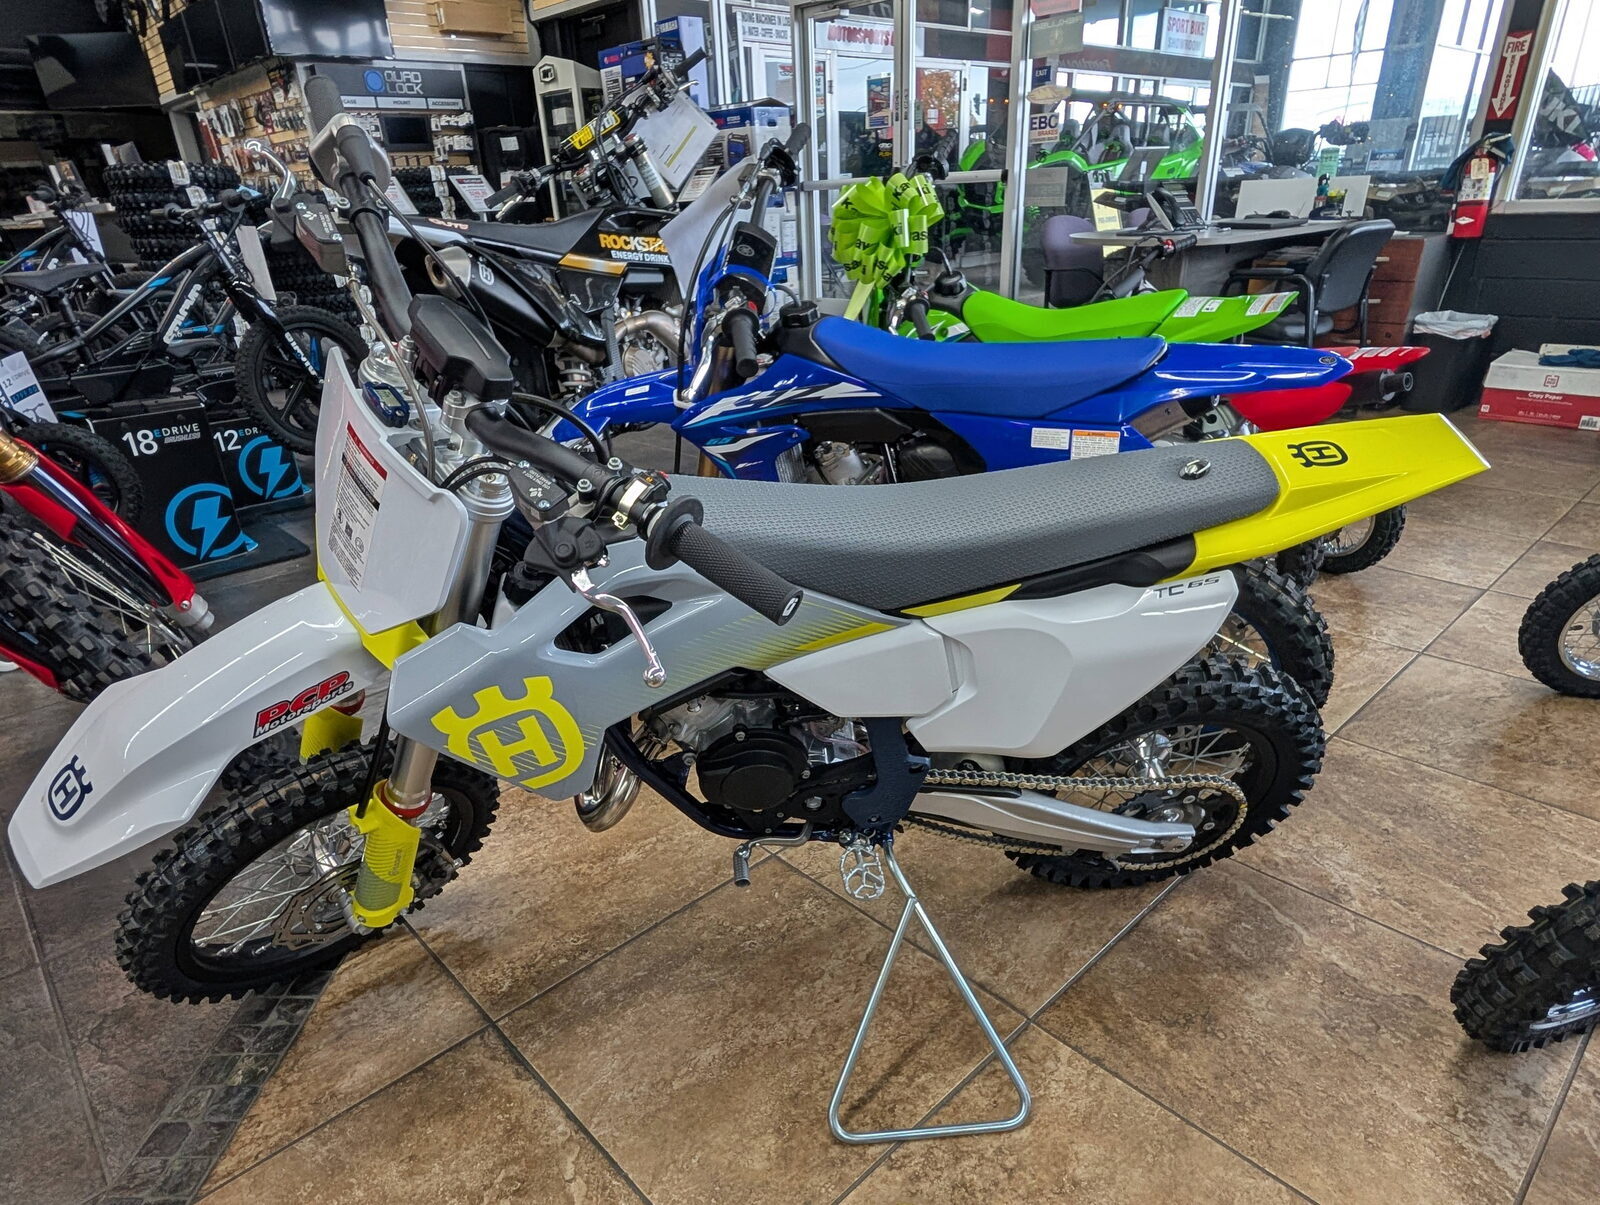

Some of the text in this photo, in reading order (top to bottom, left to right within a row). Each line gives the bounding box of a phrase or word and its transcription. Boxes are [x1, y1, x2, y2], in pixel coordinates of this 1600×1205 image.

[827, 24, 890, 46] MOTORSPORTS
[1168, 16, 1205, 36] SPORT BIKE
[1506, 40, 1527, 53] FIRE
[384, 70, 422, 83] QUAD
[1498, 55, 1516, 111] EXTINGUISHER
[386, 83, 423, 95] LOCK
[1030, 115, 1059, 130] EBC
[611, 250, 670, 263] ENERGY DRINK
[1528, 391, 1543, 400] Copy
[1544, 393, 1563, 401] Paper
[122, 429, 158, 457] 18
[164, 432, 201, 444] BRUSHLESS
[213, 426, 262, 452] 12 EDR
[1153, 575, 1221, 599] TC 65
[254, 681, 354, 738] Motorsports
[257, 671, 350, 728] PCP
